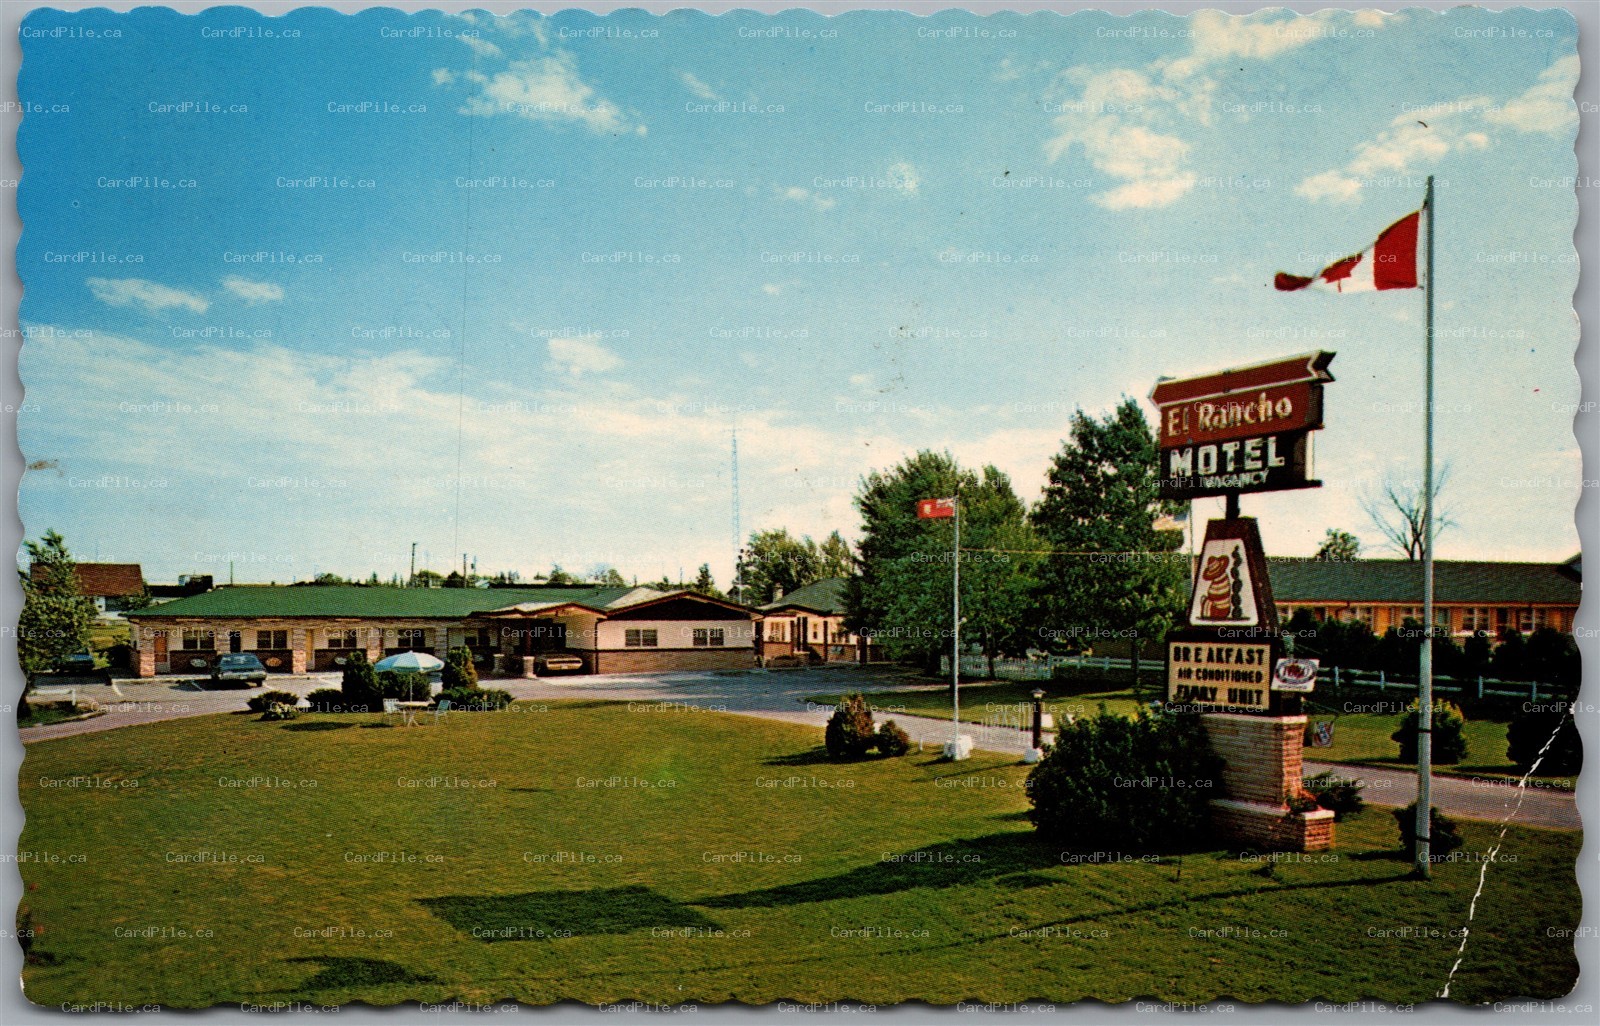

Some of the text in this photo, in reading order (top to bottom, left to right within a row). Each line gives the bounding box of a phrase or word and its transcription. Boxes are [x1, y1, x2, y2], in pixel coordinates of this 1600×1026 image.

[1167, 392, 1293, 437] El Rancho
[1169, 436, 1286, 479] MOTEL
[1203, 468, 1270, 489] VACANCY
[1173, 646, 1265, 666] BREAKFAST
[1178, 667, 1194, 680] AIR
[1196, 667, 1264, 684] CONDITIONED
[1227, 687, 1264, 706] UNIT
